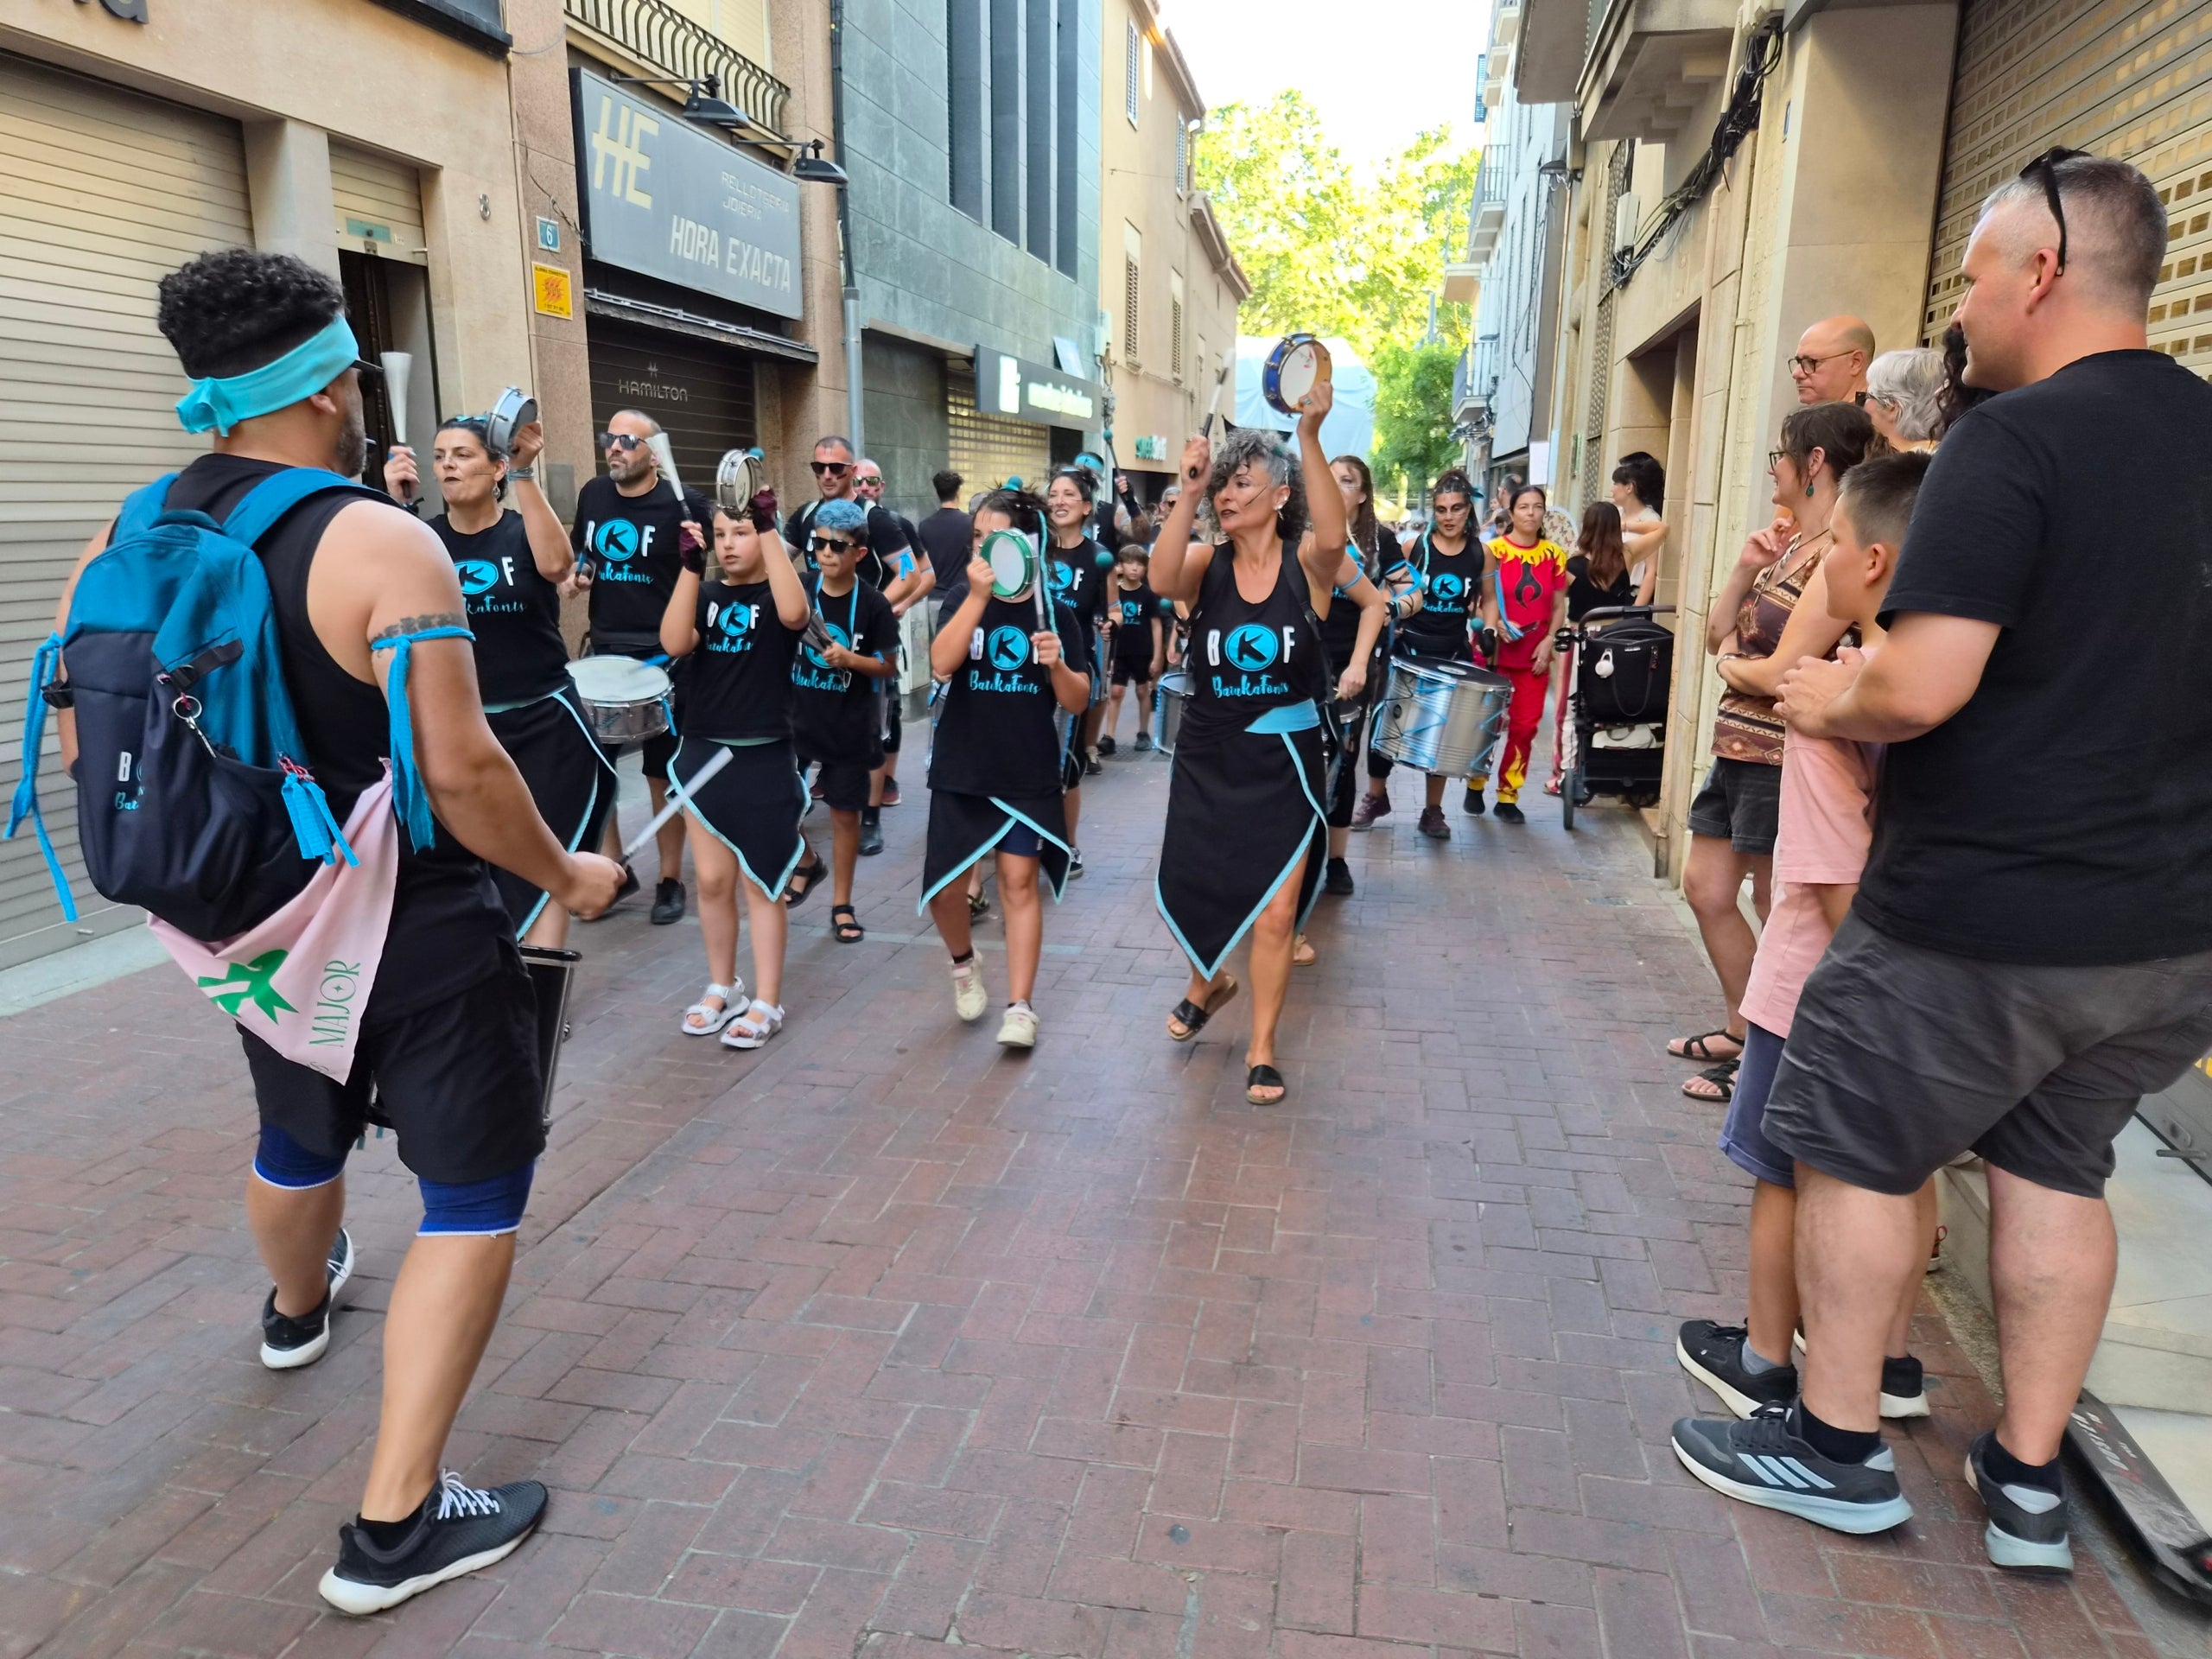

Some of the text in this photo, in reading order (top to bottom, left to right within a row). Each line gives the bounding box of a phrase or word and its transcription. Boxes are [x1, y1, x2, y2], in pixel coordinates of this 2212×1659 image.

[479, 194, 491, 221] 8
[546, 224, 553, 245] 6
[670, 214, 791, 293] HORA EXACTA
[308, 960, 361, 1048] MAJOR
